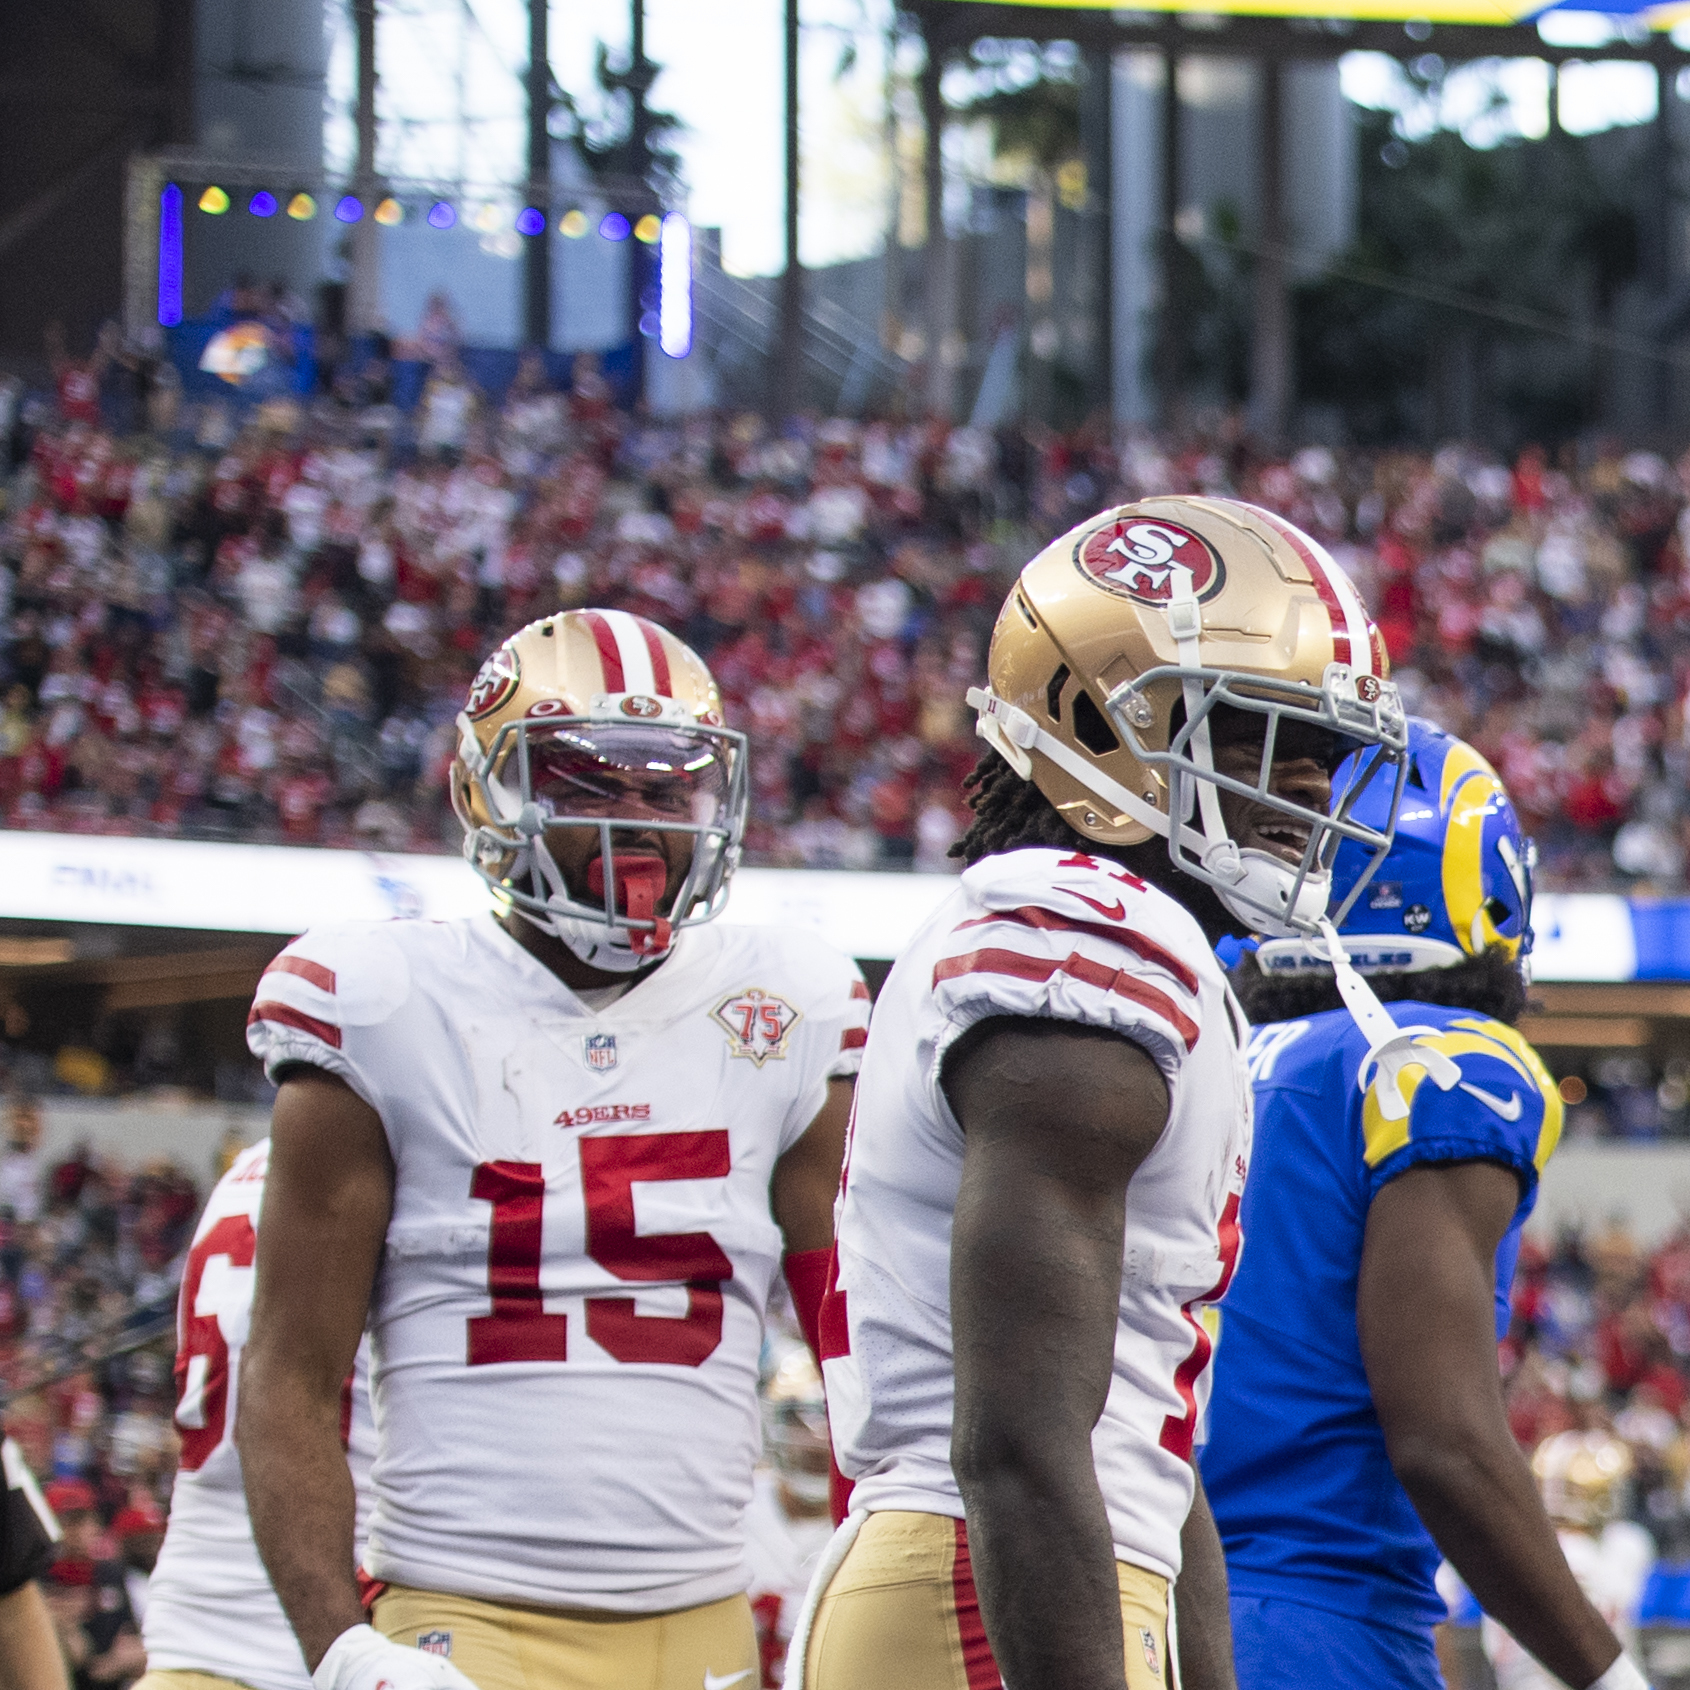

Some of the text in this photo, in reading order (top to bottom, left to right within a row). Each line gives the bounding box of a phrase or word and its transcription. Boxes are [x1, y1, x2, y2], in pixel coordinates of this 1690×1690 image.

[732, 1002, 783, 1046] 75
[588, 1048, 616, 1068] NFL
[554, 1102, 651, 1129] 49ERS
[466, 1138, 734, 1367] 15
